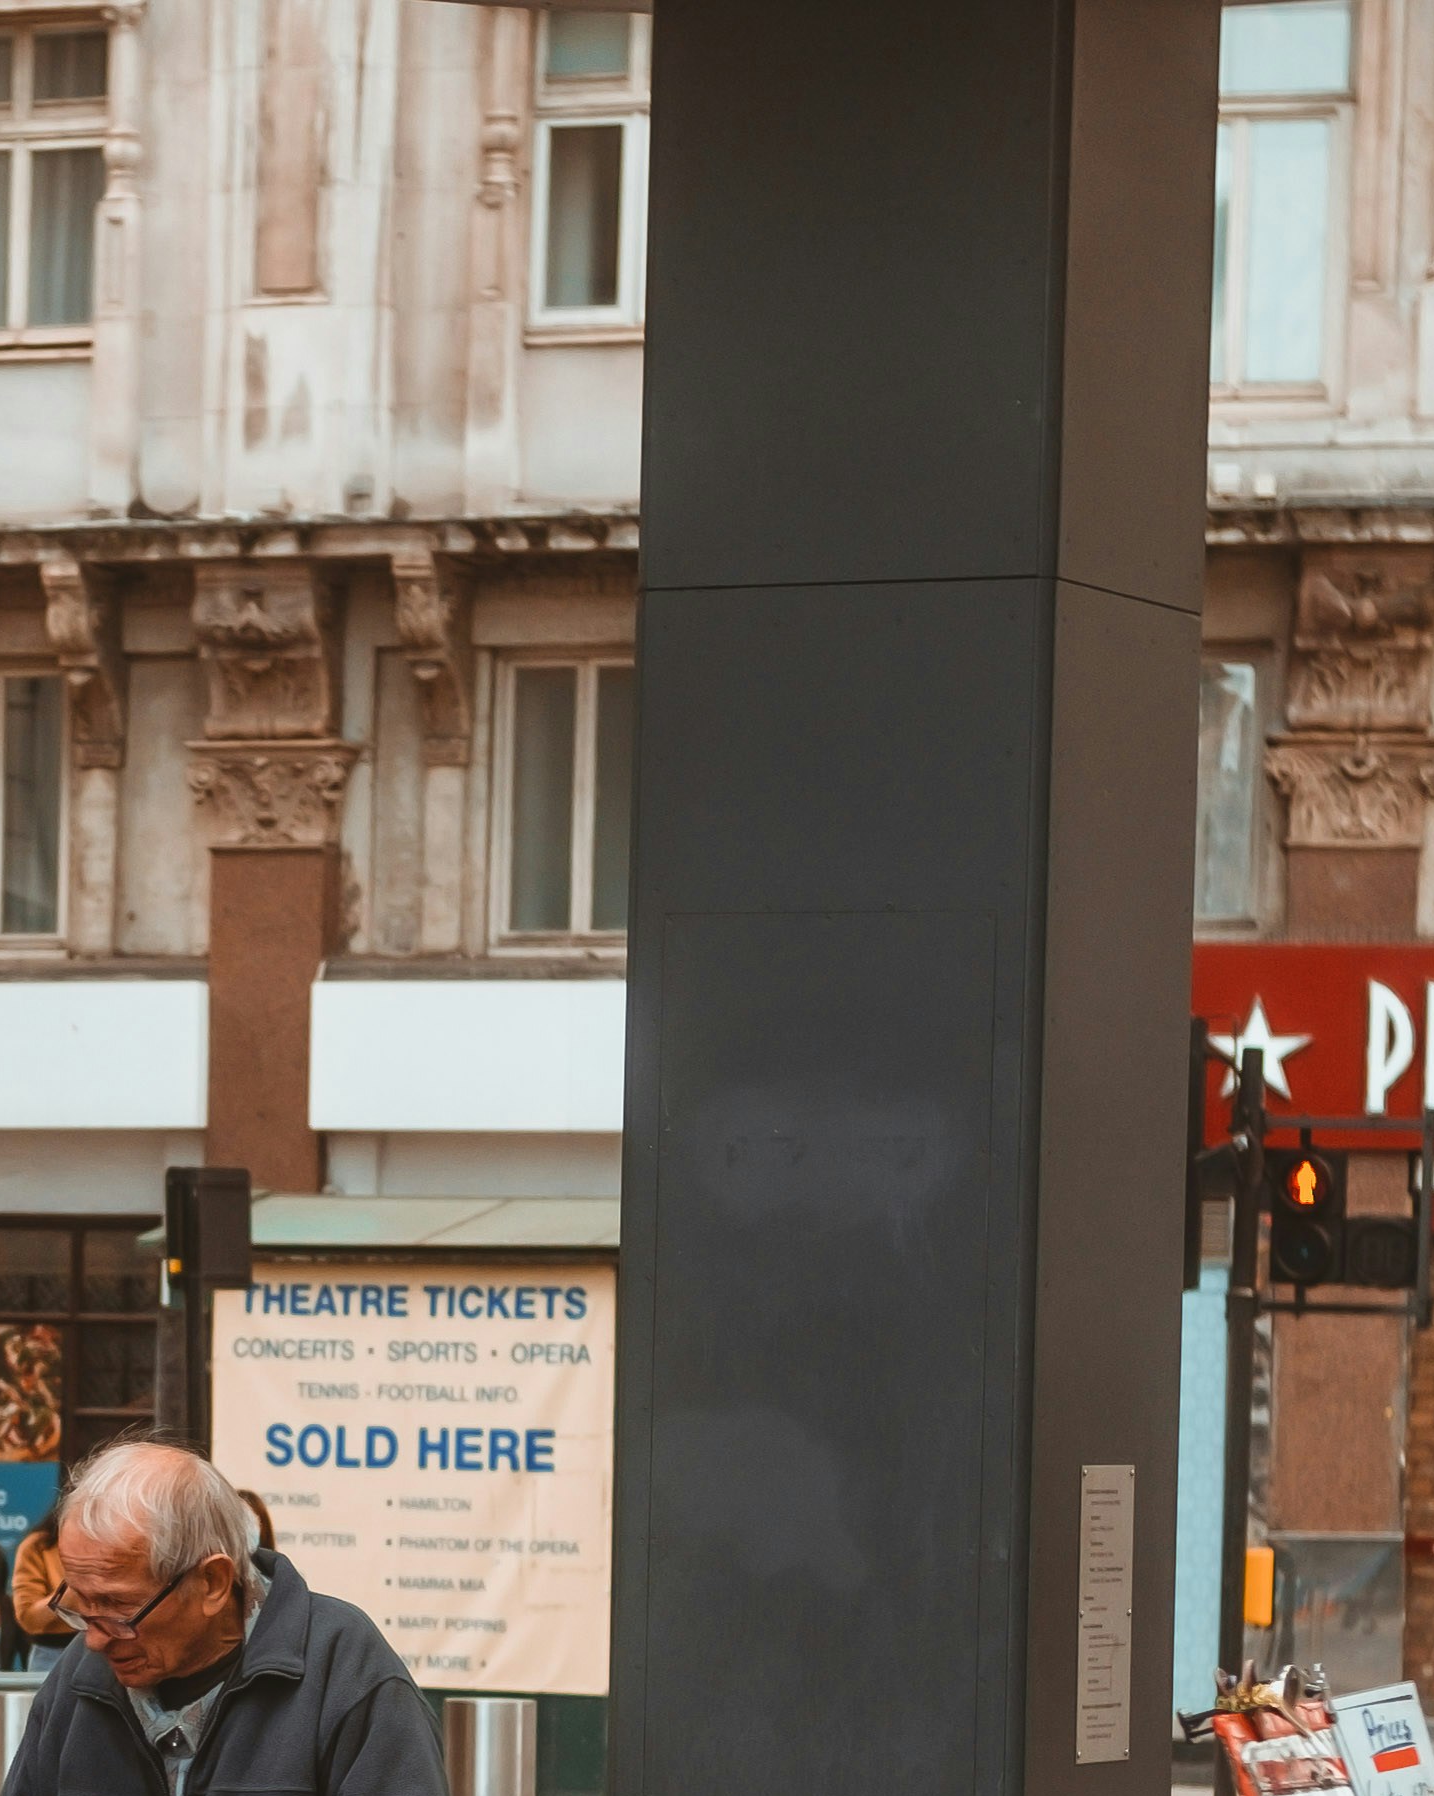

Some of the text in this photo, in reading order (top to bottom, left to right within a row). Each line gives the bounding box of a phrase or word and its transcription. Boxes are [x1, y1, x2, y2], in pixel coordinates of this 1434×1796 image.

[244, 1283, 588, 1320] THEATRE TICKETS
[233, 1337, 592, 1365] CONCERTS SPORTS OPERA
[298, 1381, 360, 1400] TENNIS
[378, 1384, 468, 1402] FOOTBALL
[265, 1422, 556, 1473] SOLD HERE
[399, 1537, 581, 1555] PHANTOM OF THE OPERA
